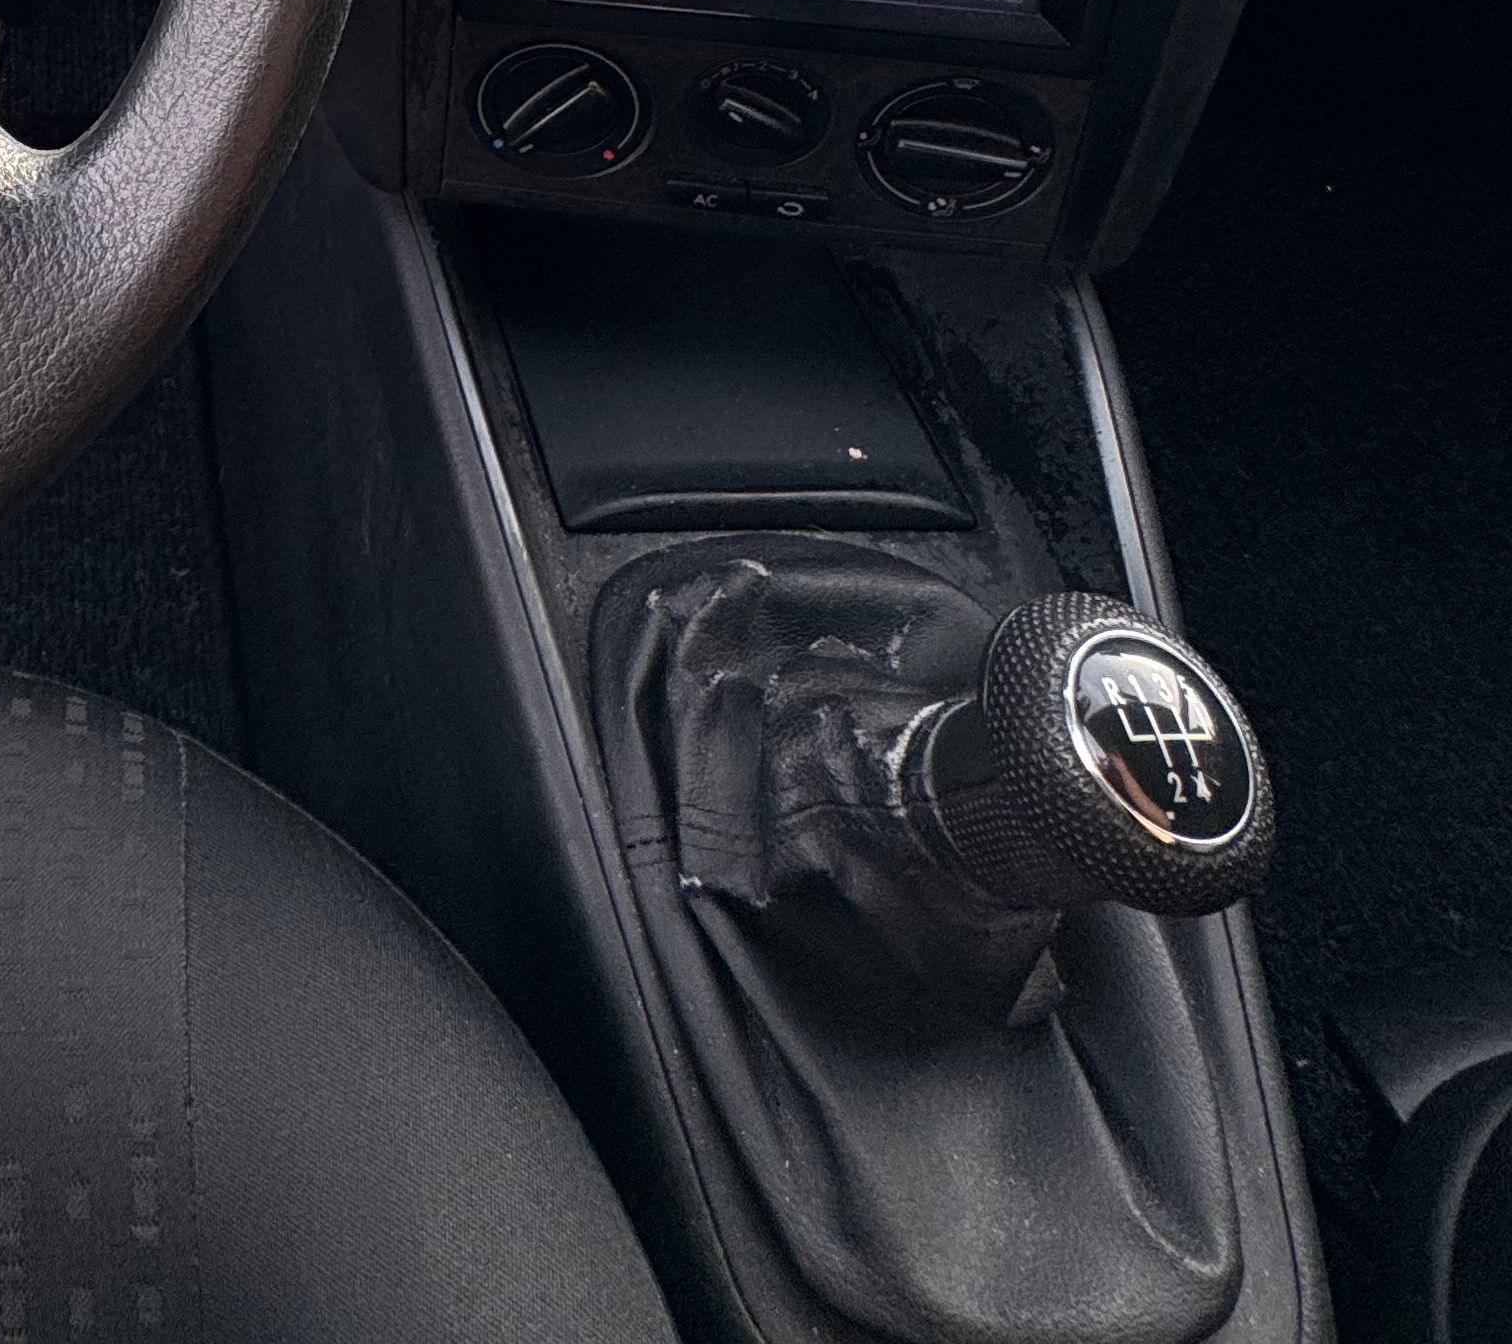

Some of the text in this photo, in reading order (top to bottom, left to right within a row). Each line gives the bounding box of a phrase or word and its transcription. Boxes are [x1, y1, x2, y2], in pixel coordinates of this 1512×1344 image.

[693, 193, 719, 208] AC
[1101, 672, 1200, 706] R 1 3 5
[1167, 769, 1213, 803] 2 4
